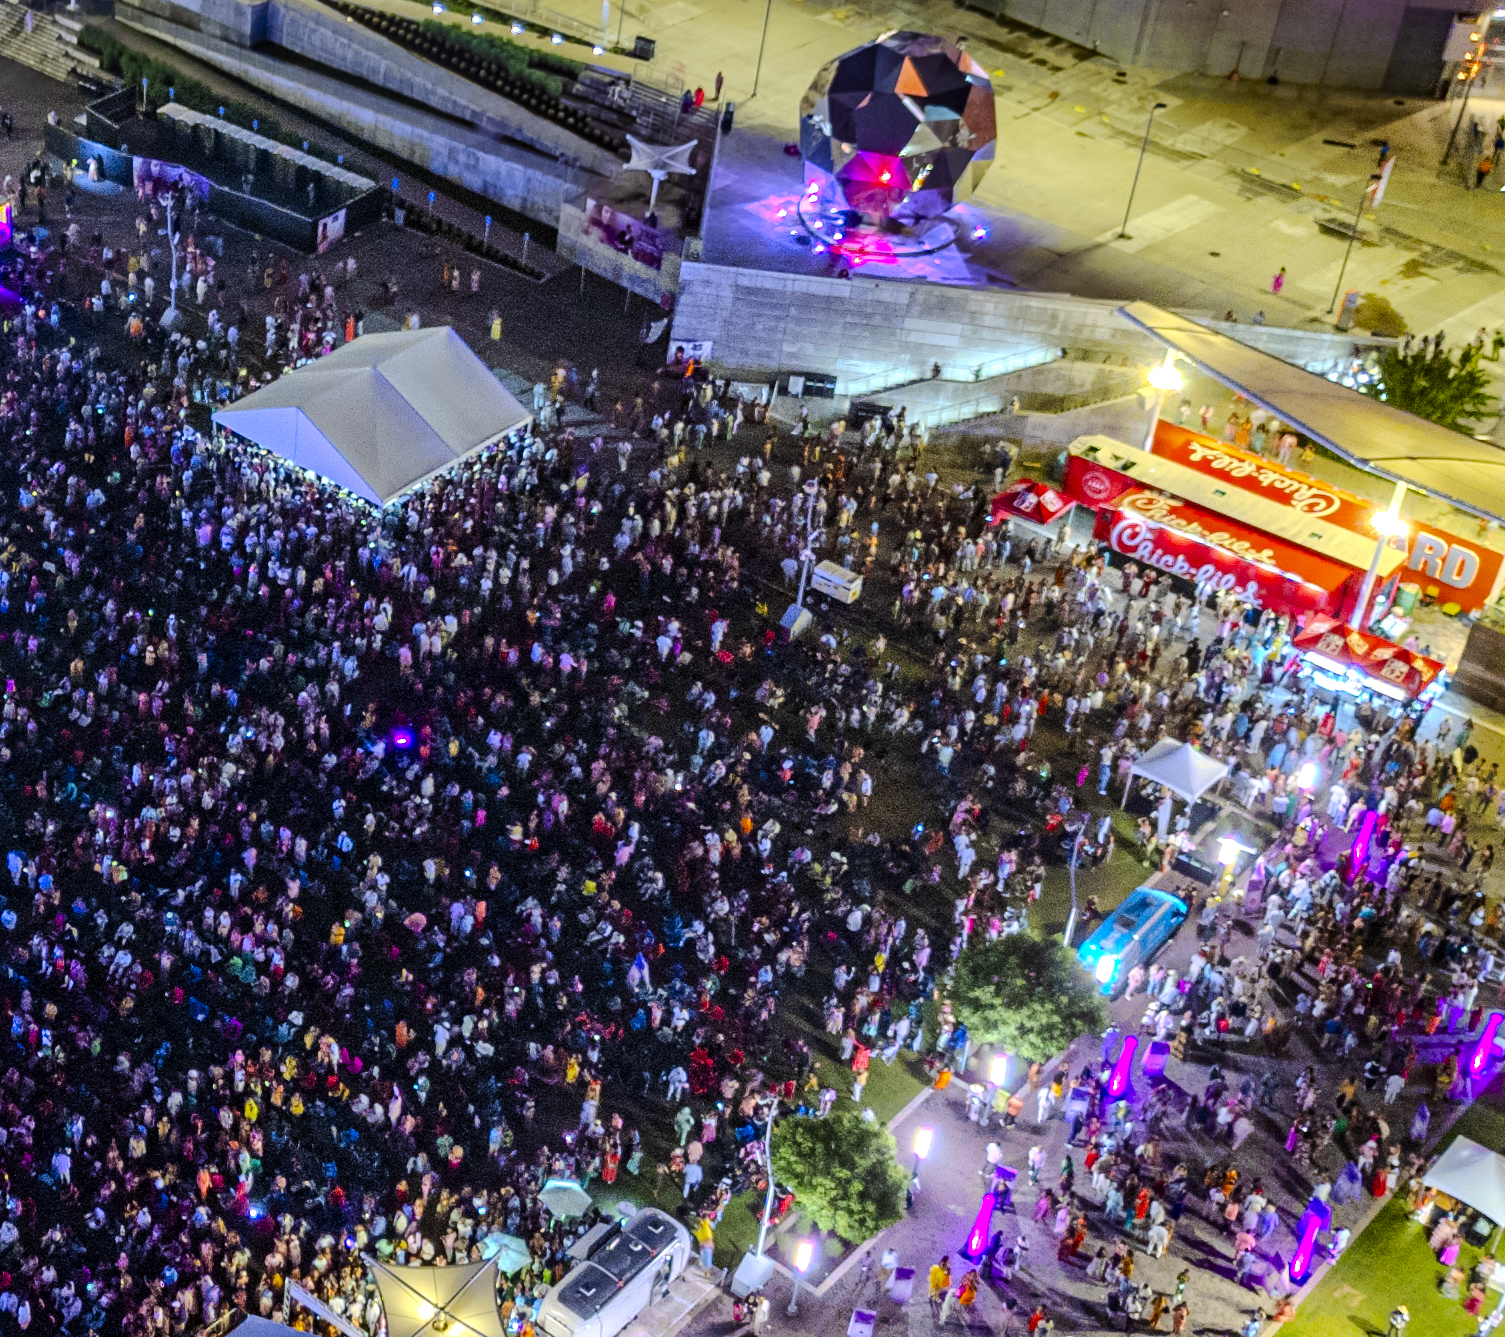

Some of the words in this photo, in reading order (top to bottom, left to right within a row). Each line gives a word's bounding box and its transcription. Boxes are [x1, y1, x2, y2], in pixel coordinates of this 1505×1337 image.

[1187, 440, 1343, 518] Chick-fil-A
[1110, 517, 1264, 609] Chick-fil-A
[1121, 488, 1277, 566] Chick-fil-A
